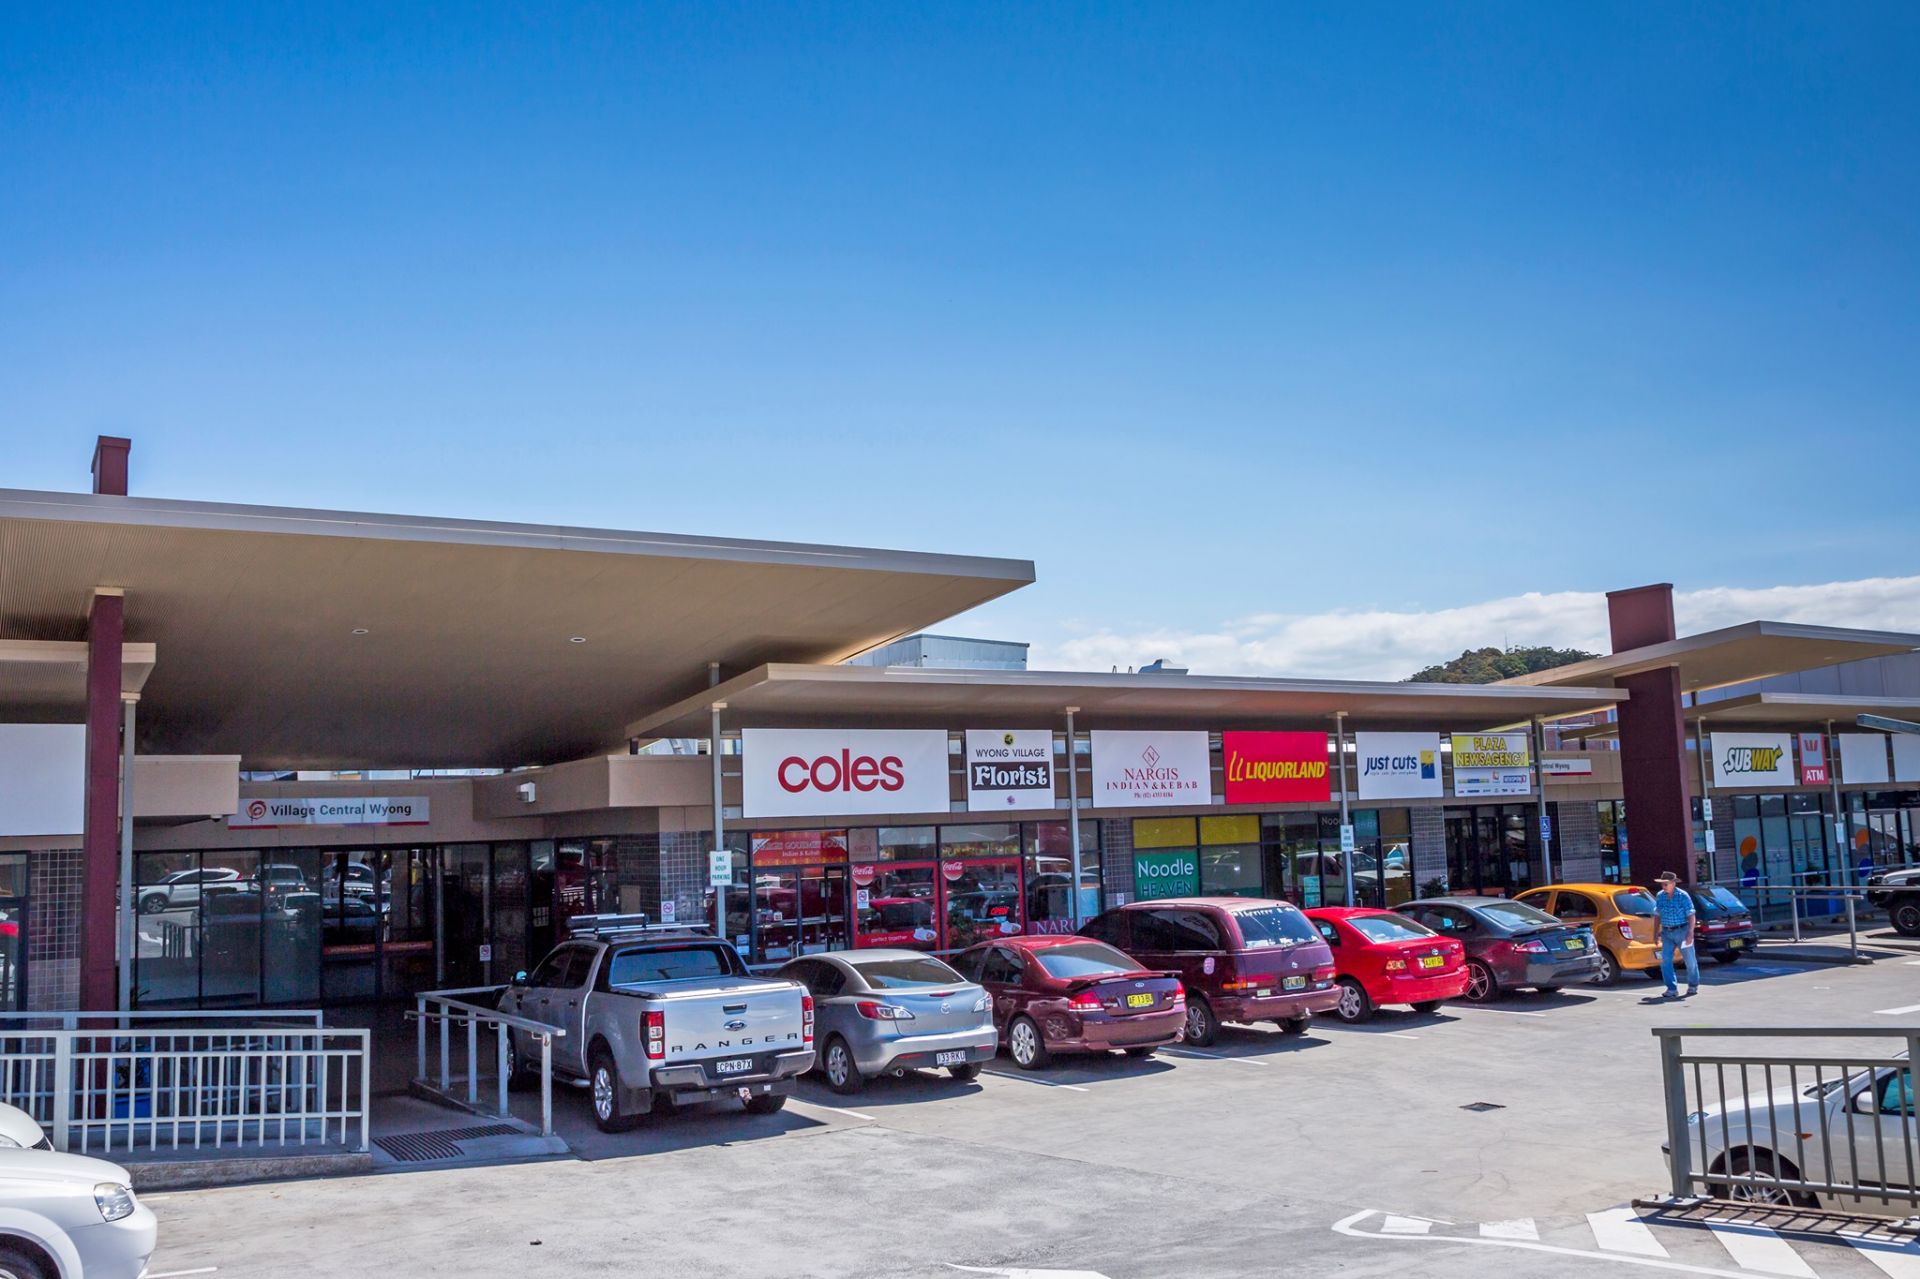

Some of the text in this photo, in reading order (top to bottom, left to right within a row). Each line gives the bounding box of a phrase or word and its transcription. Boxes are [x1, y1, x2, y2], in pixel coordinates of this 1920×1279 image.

[976, 748, 1045, 757] WYONG VILLAGE
[1473, 737, 1507, 751] PLAZA
[1455, 752, 1526, 766] NEWSAGENCY
[1723, 744, 1783, 775] SUBWAY
[777, 748, 905, 793] coles
[974, 764, 1048, 786] Florist
[1124, 767, 1179, 780] NARGIS
[1245, 761, 1326, 782] LIQUORLAND
[1806, 769, 1824, 781] ATM
[271, 803, 412, 818] Village Central Wyong
[1138, 859, 1194, 878] Noodle
[1141, 880, 1193, 897] HEAVEN
[671, 1032, 798, 1053] RANGER
